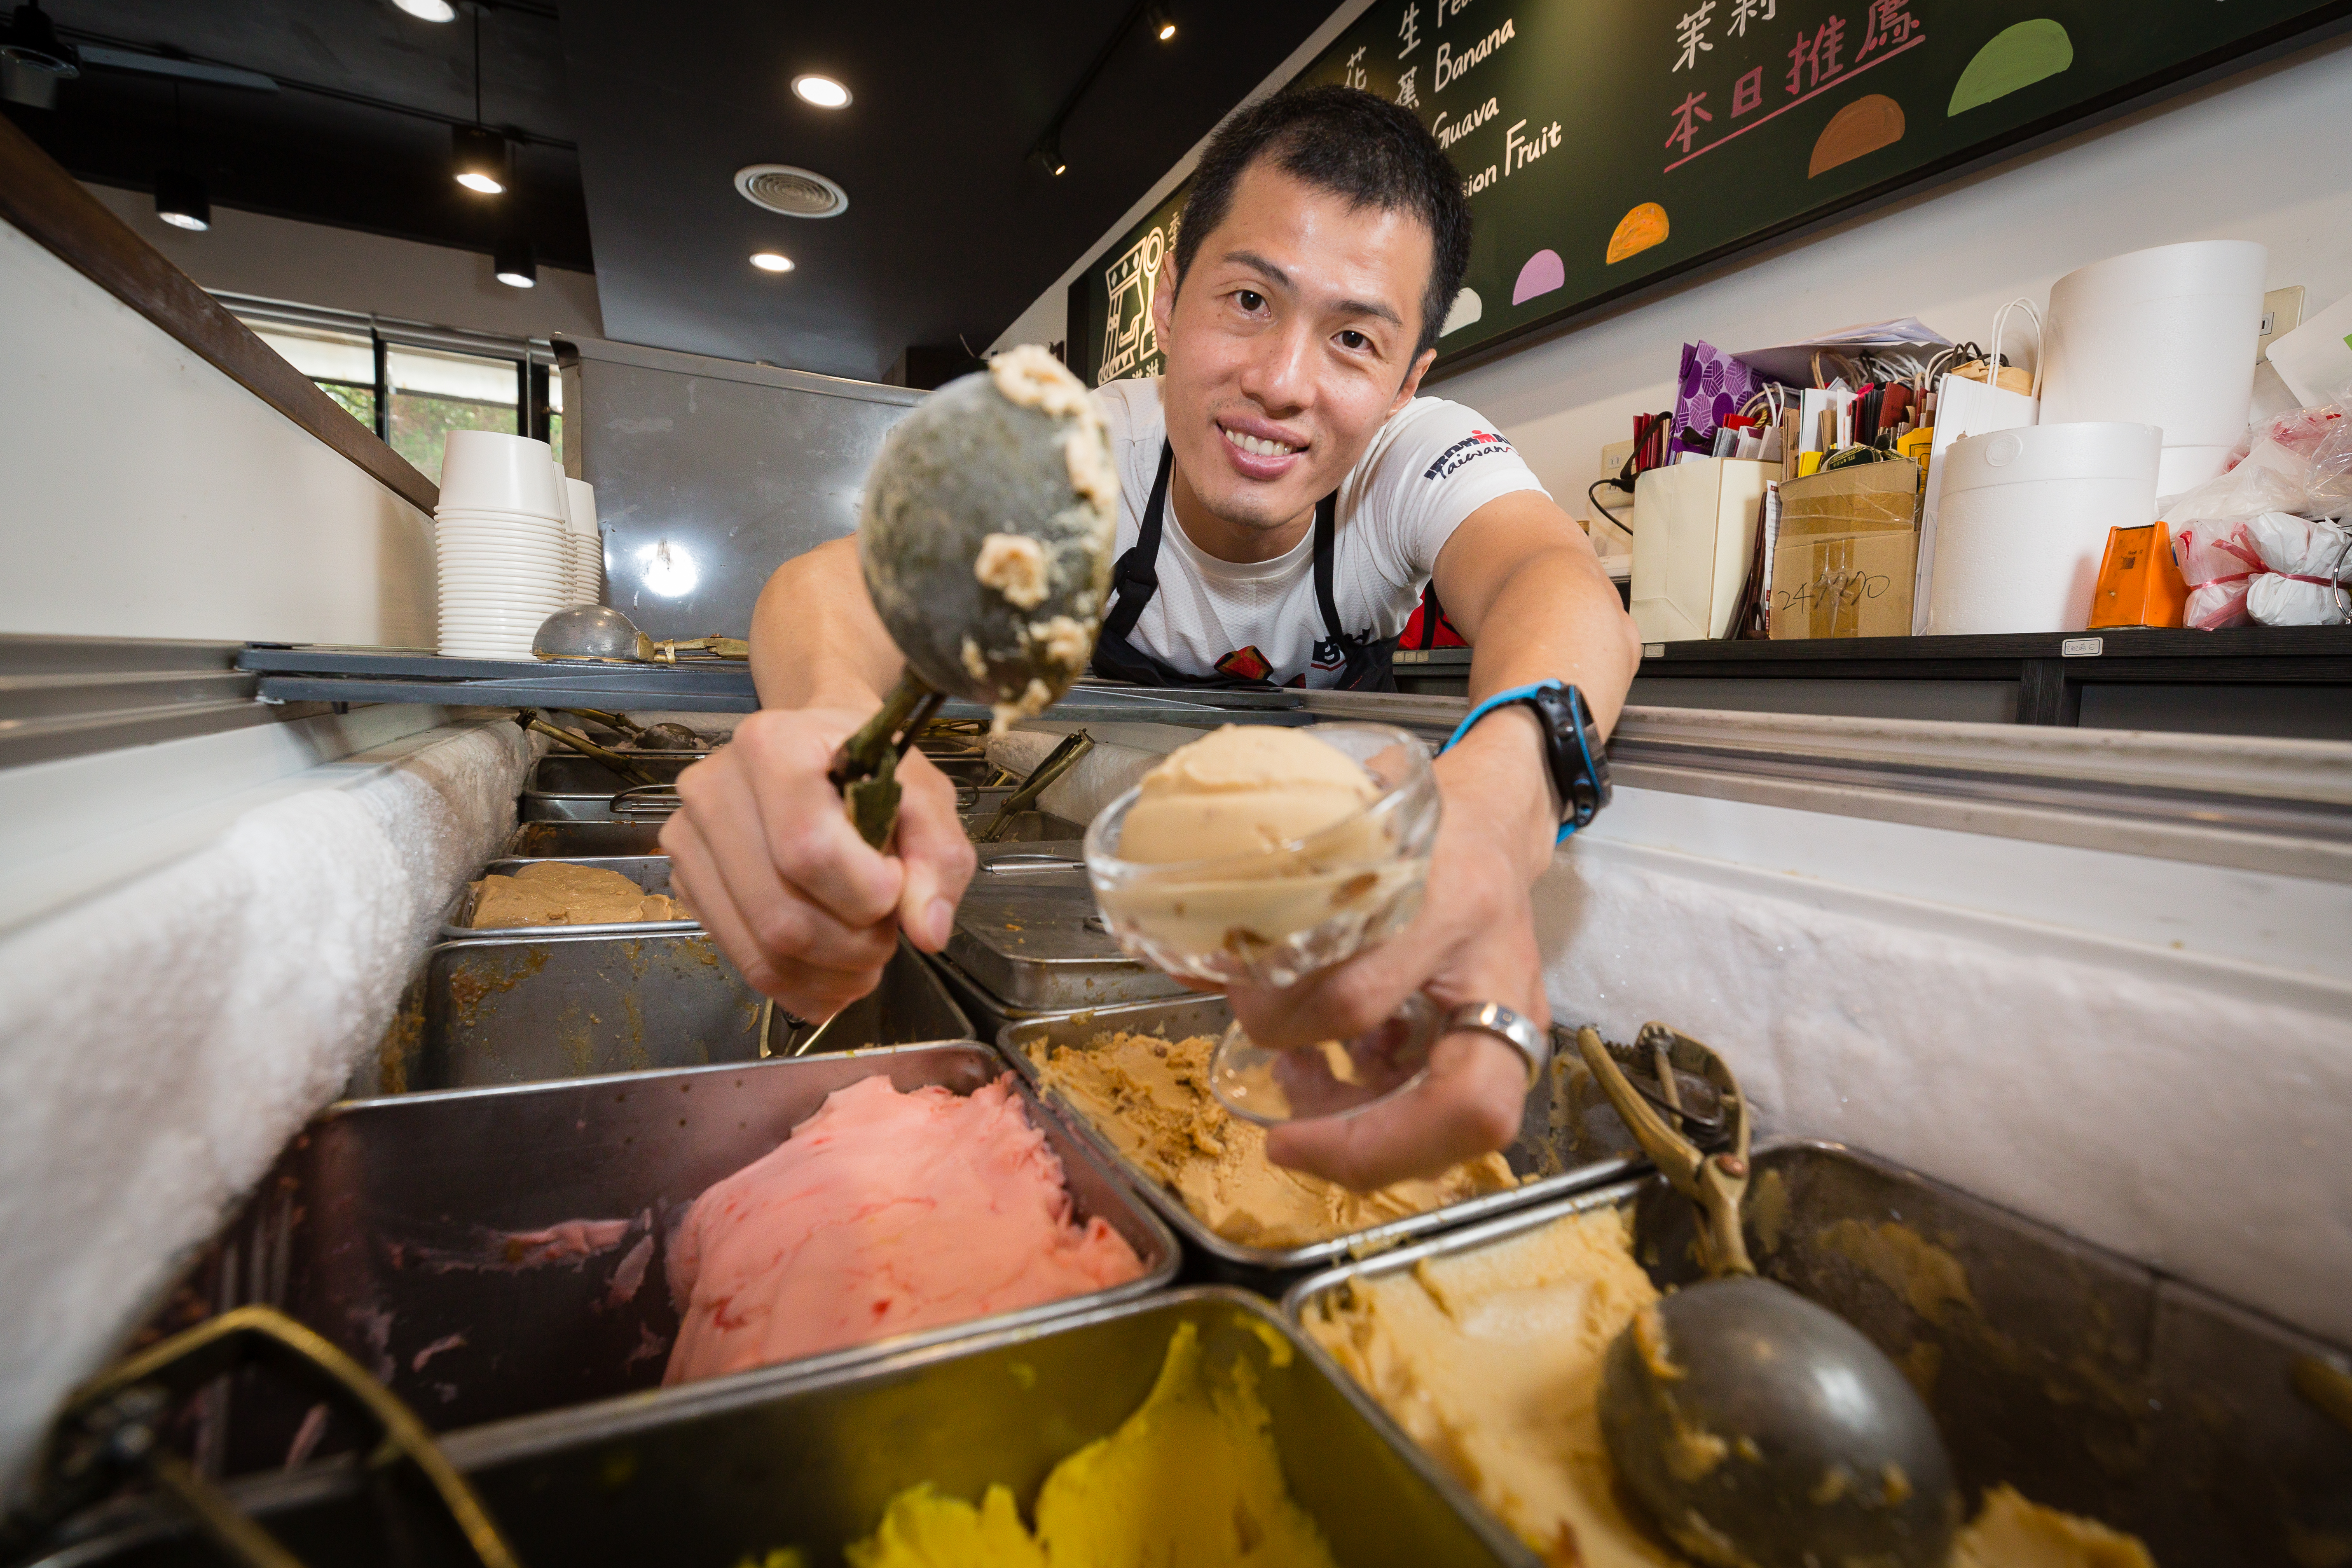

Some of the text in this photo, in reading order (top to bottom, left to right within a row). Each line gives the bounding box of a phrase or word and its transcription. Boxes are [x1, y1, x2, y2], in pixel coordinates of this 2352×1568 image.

[1435, 18, 1515, 93] Banana
[1432, 97, 1500, 150] Guava
[1461, 119, 1562, 199] ion Fruit
